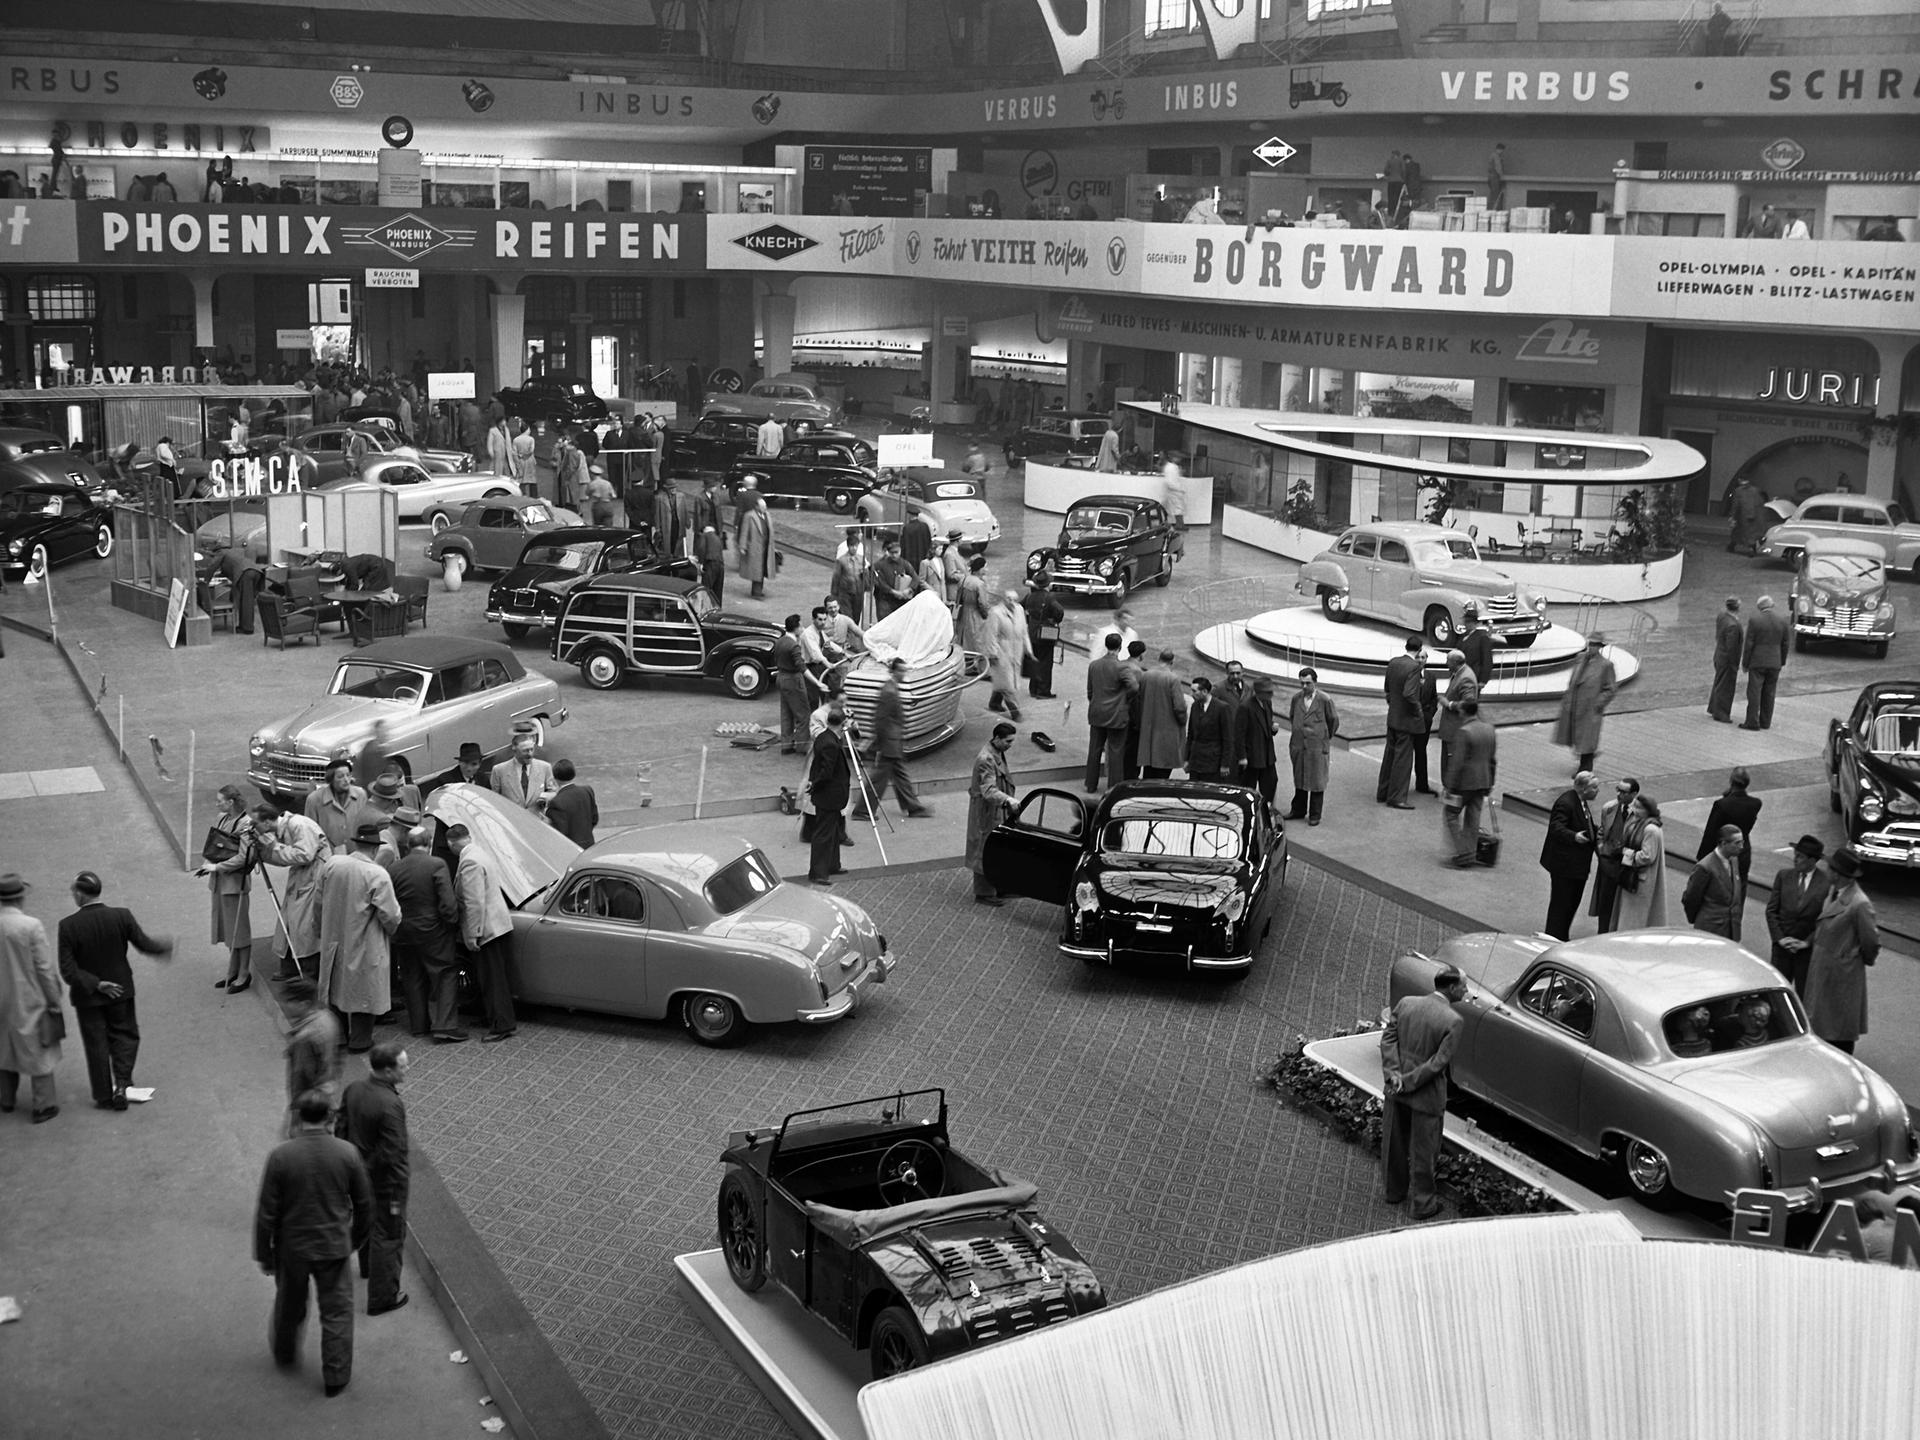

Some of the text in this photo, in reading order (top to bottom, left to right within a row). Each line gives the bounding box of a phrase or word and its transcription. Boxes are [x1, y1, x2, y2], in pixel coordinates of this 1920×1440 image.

[335, 85, 359, 99] B&S
[1164, 81, 1238, 111] INBUS
[1441, 68, 1920, 101] VERBUS SCHR
[579, 91, 694, 117] INBUS
[985, 95, 1057, 122] VERBUS
[54, 120, 256, 152] PHOENIX
[103, 212, 679, 259] PHOENIX REIFEN
[386, 229, 433, 241] PHOENIX
[389, 241, 430, 249] HARBURG
[744, 235, 808, 249] KNECHT
[838, 224, 886, 264] Filter
[932, 237, 1089, 276] Fahrt VEITH Reifen
[1146, 252, 1188, 265] GEGENÜBER
[1193, 238, 1515, 297] BORGWARD
[371, 278, 414, 286] VERBOTEN
[1657, 281, 1754, 296] LIEFERWAGEN
[1100, 312, 1136, 329] ALFRED
[1140, 316, 1171, 332] TEVES
[1270, 327, 1449, 353] ARMATURENFABRIK
[1470, 338, 1502, 354] KG.
[1515, 319, 1601, 364] Ate
[211, 454, 302, 498] SIMCA
